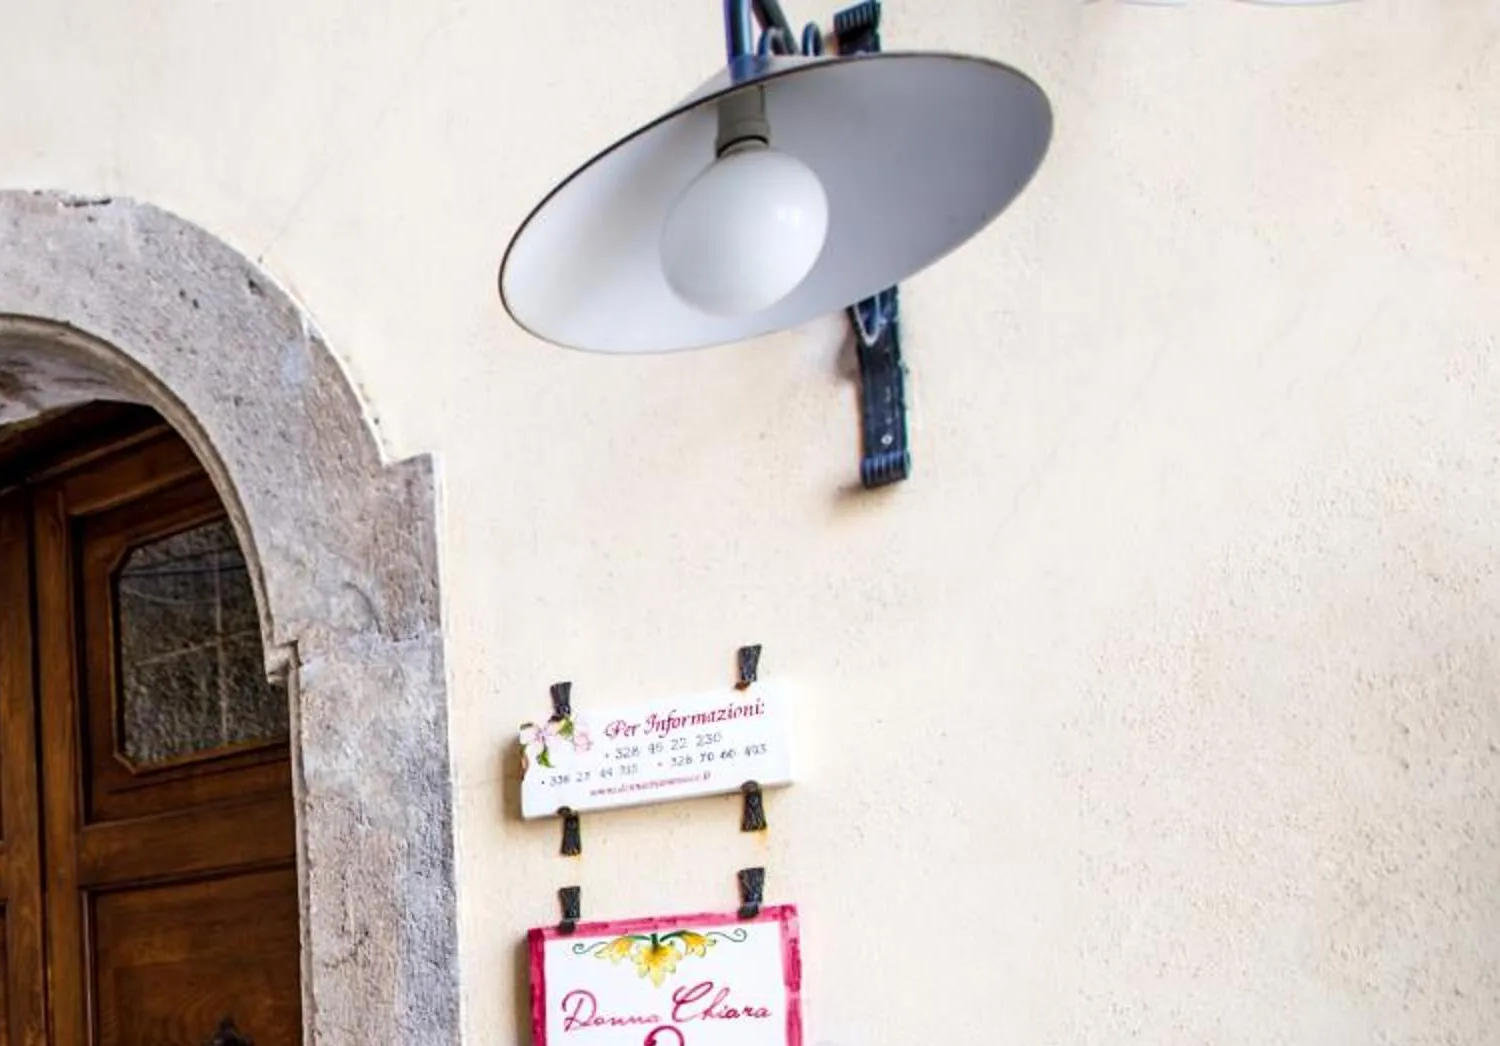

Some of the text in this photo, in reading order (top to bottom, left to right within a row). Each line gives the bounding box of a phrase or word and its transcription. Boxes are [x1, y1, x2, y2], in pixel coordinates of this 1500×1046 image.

[603, 697, 765, 739] Per Informazioni:
[561, 981, 773, 1033] Donna Chiara
